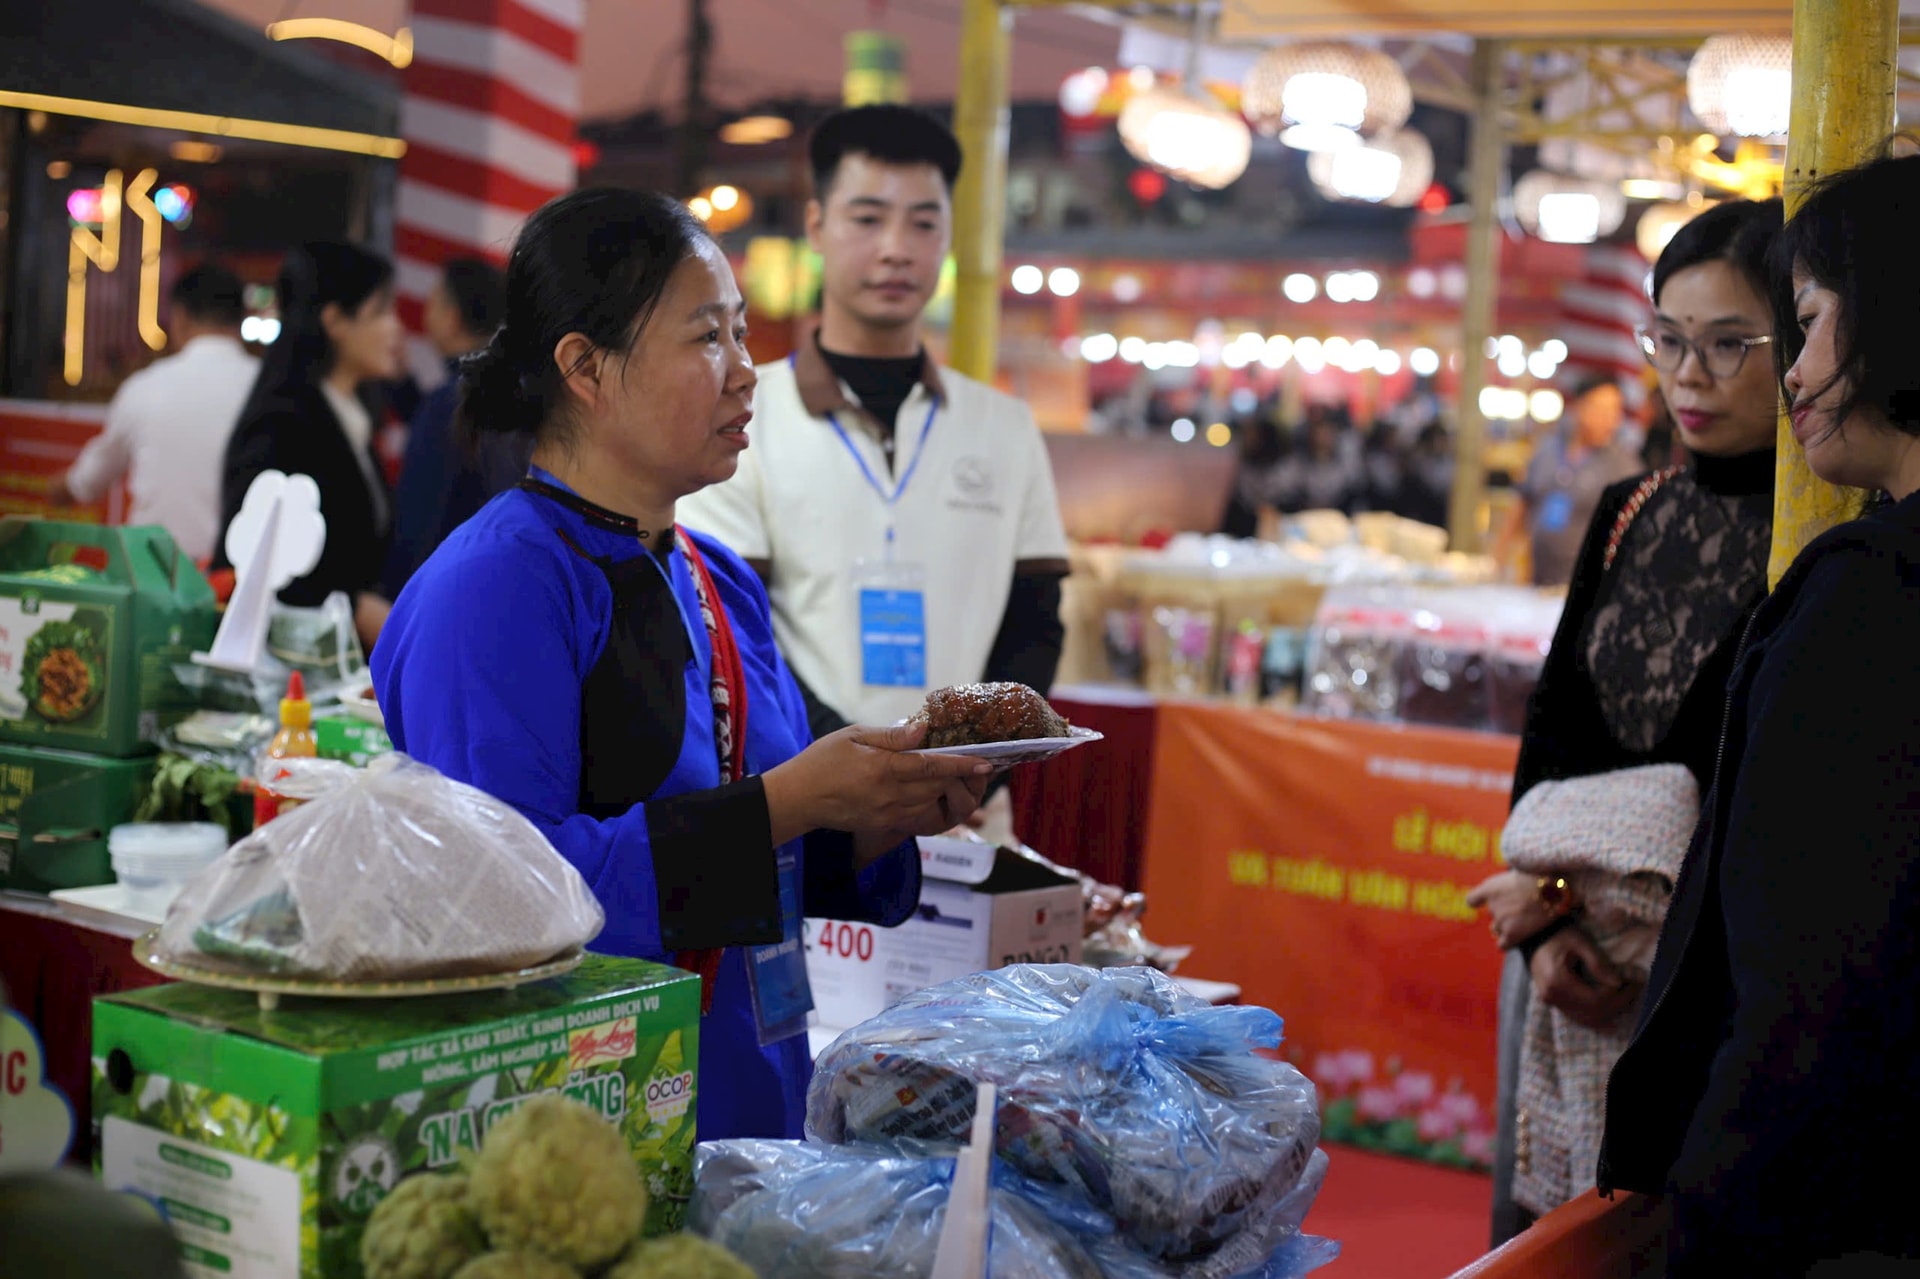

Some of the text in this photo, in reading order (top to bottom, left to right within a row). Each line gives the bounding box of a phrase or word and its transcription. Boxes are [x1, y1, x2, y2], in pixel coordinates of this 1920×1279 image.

[820, 920, 874, 961] 400
[567, 1005, 610, 1029] DOANH
[613, 998, 641, 1019] DỊCH
[643, 995, 660, 1012] VỤ
[647, 1073, 692, 1102] OCOP
[419, 1108, 480, 1167] NA
